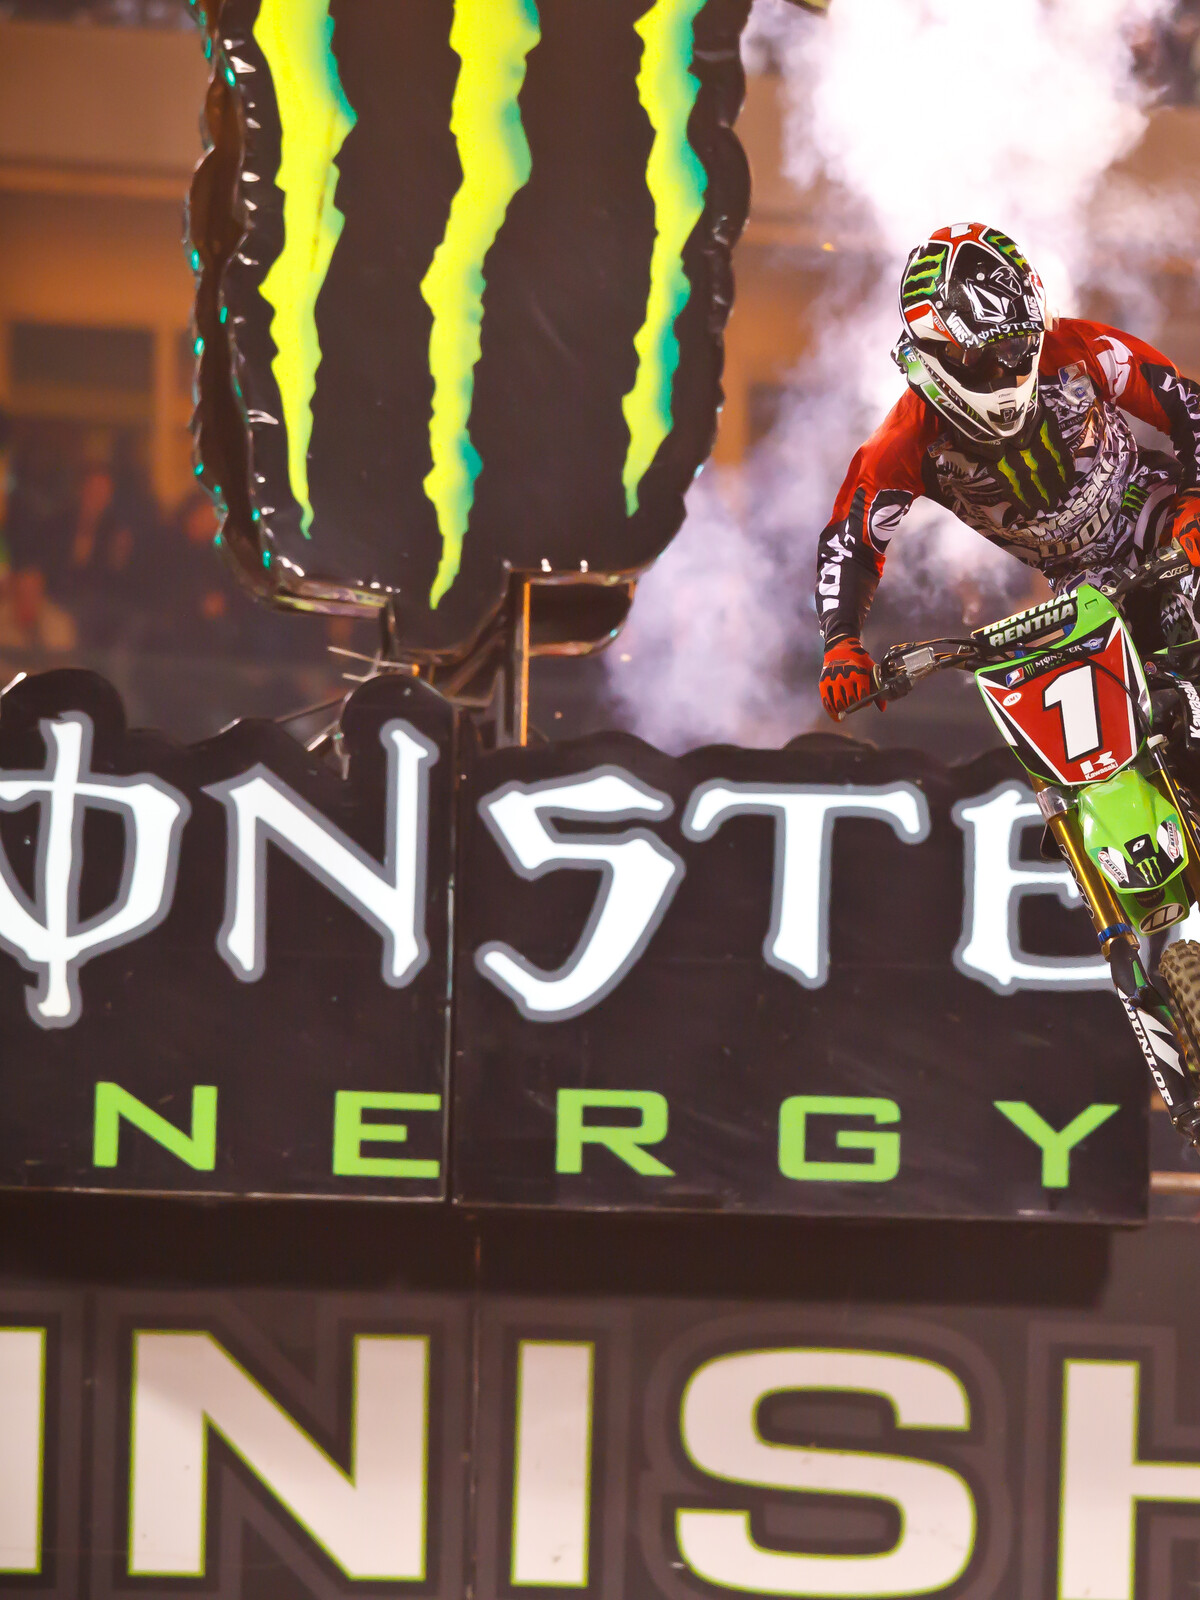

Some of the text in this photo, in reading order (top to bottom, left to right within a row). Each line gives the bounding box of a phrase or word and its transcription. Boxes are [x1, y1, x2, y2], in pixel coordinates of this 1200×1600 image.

[946, 310, 974, 344] VANS
[966, 320, 1043, 348] MONSTER
[989, 602, 1077, 647] RENTHA
[1042, 663, 1103, 763] 1
[1084, 760, 1119, 780] Kawasaki
[1126, 1004, 1174, 1107] DUNLOP
[93, 1081, 1121, 1188] NERGY
